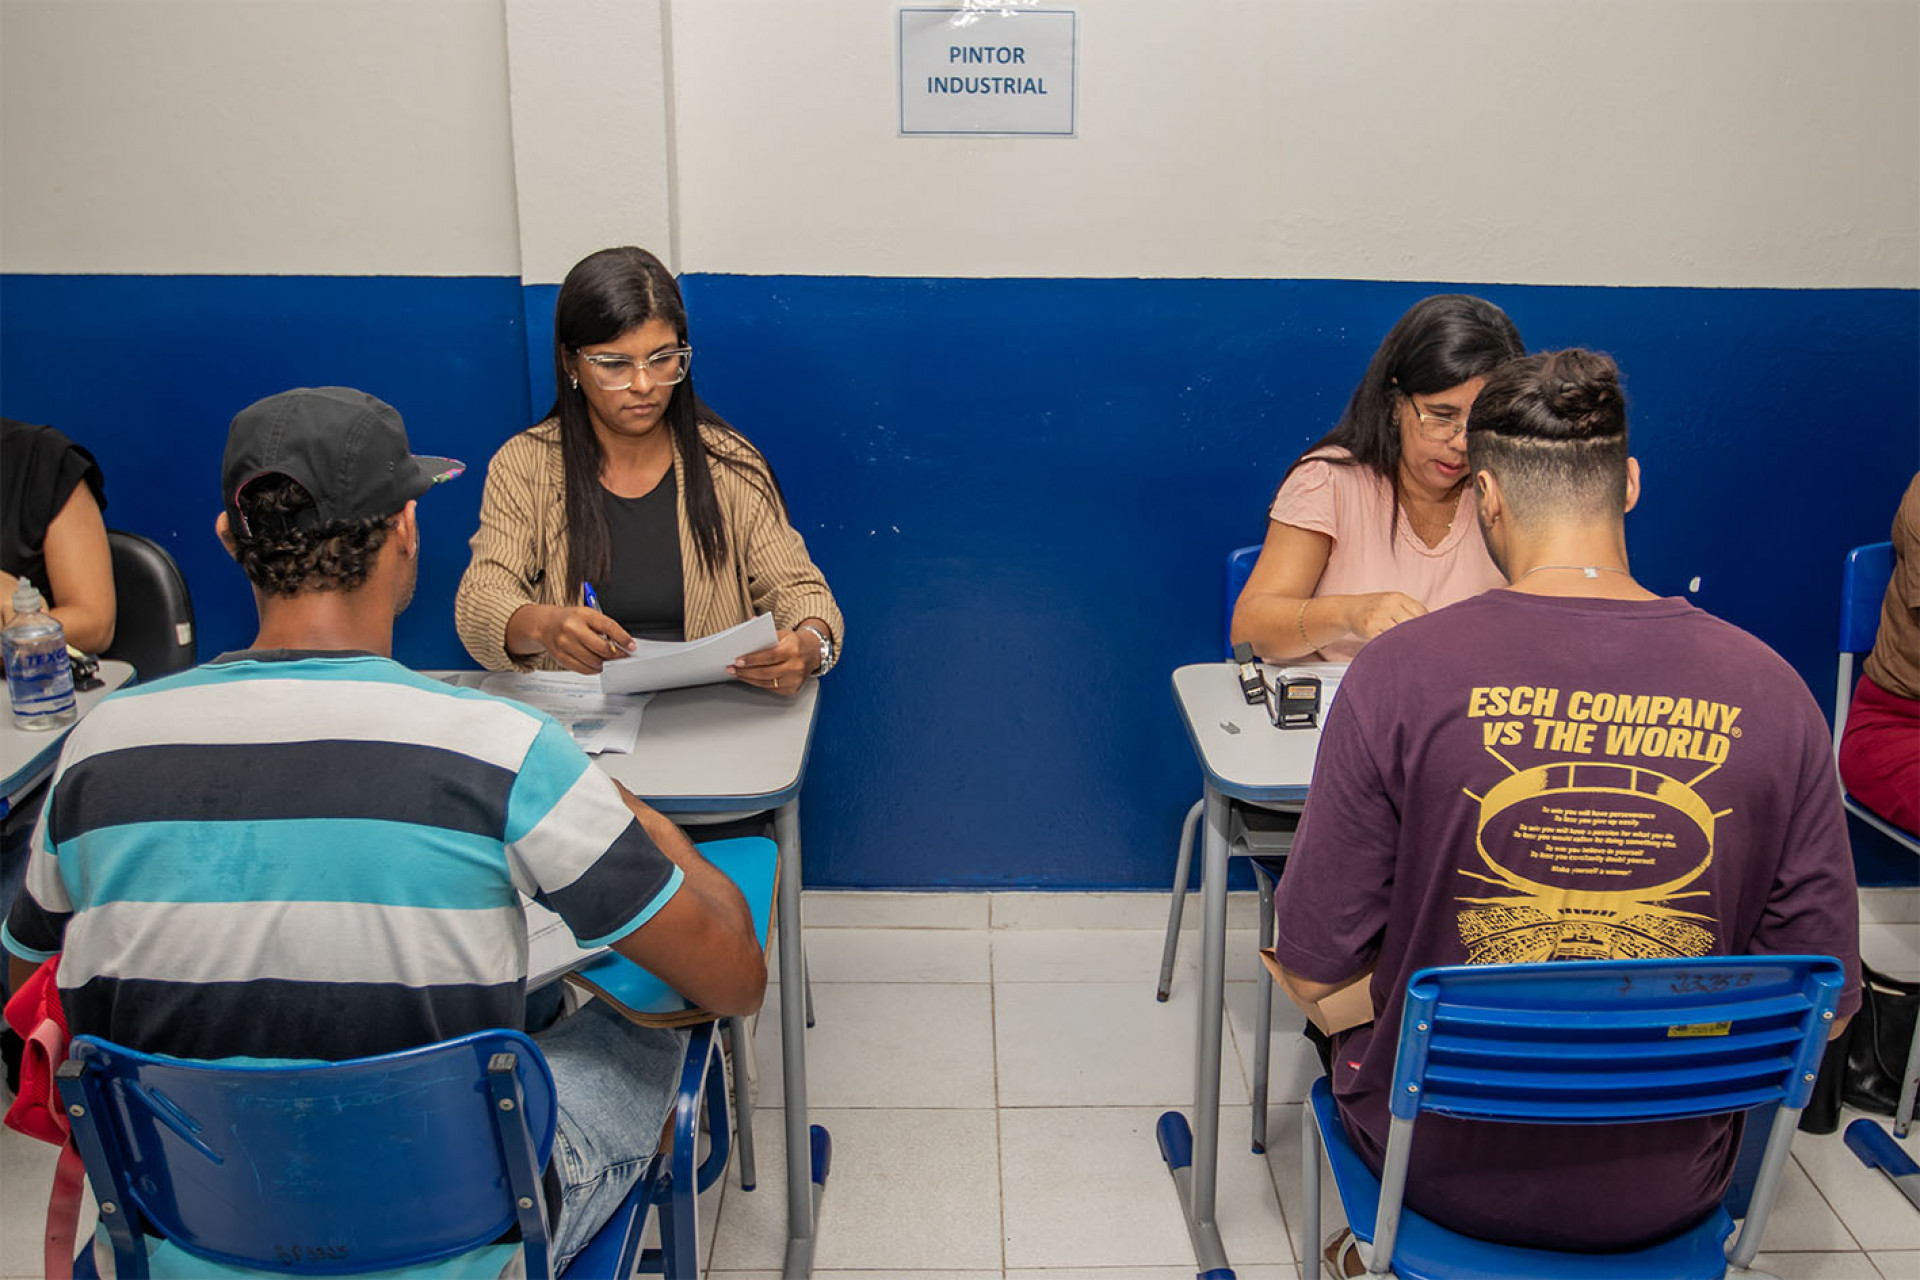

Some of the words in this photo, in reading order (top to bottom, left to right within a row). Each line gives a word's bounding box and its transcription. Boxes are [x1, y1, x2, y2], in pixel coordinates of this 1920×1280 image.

[949, 46, 1025, 64] PINTOR
[927, 76, 1047, 95] INDUSTRIAL
[1467, 686, 1559, 718] ESCH
[1567, 690, 1741, 734] COMPANY
[1534, 719, 1594, 754] THE
[1606, 725, 1731, 764] WORLD
